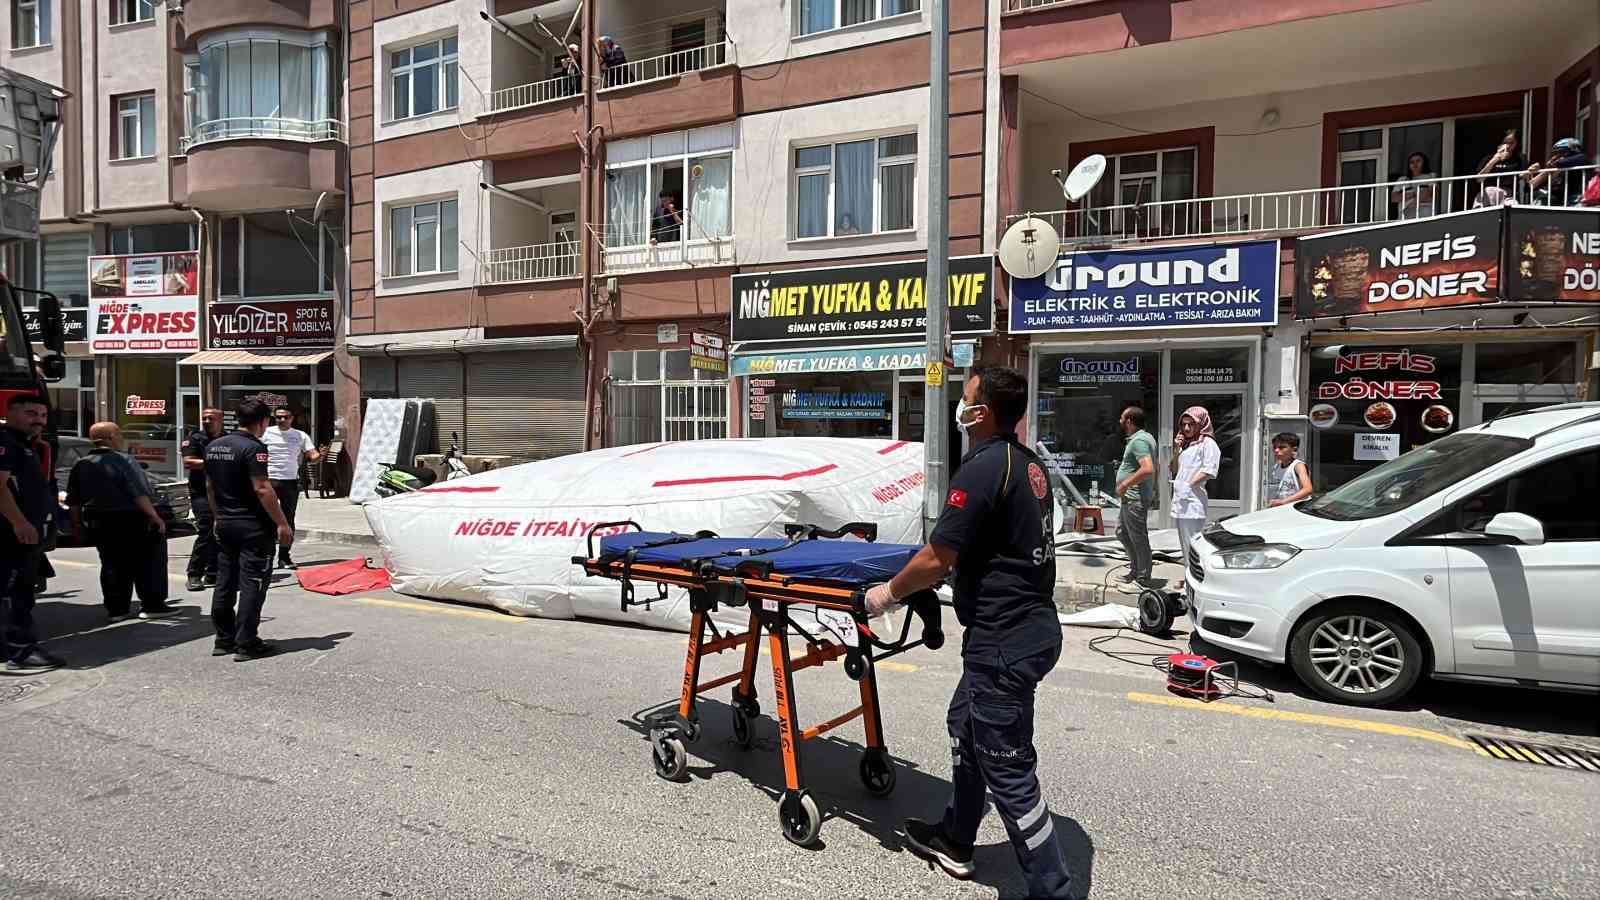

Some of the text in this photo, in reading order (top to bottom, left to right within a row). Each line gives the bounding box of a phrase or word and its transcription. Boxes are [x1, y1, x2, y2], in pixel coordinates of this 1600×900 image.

[1380, 233, 1477, 268] NEFİS
[739, 273, 986, 319] NİĞMET YUFKA & KAYIF
[1368, 270, 1487, 304] DÖNER
[99, 300, 129, 313] NİĞDE
[1025, 286, 1262, 313] ELEKTRİK & ELEKTRONİK
[296, 307, 328, 319] SPOT &
[1028, 316, 1046, 325] PLAN
[1052, 315, 1075, 325] PROJE
[1080, 312, 1113, 323] TAAHHÜT
[1120, 311, 1166, 322] AYDINLATMA
[1175, 309, 1205, 320] TESİSAT
[1211, 309, 1234, 319] ARIZA
[1236, 308, 1261, 318] BAKIM
[96, 312, 196, 334] EXPRESS
[213, 312, 288, 334] YILDIZER
[788, 322, 816, 333] SİNAN
[818, 320, 847, 334] ÇEVİK
[854, 320, 878, 330] 0545
[880, 319, 898, 329] 243
[901, 318, 914, 327] 57
[810, 356, 857, 372] YUFKA
[862, 356, 873, 369] &
[1060, 356, 1139, 374] Ground
[1334, 348, 1436, 374] NEFİS
[1318, 377, 1443, 400] DÖNER
[128, 400, 165, 409] EXPRESS
[815, 392, 840, 407] YUFKA
[842, 393, 849, 406] &
[850, 391, 884, 406] KADAYIF
[455, 518, 521, 536] NİĞDE
[773, 667, 783, 690] PLUS
[780, 716, 789, 734] TAY
